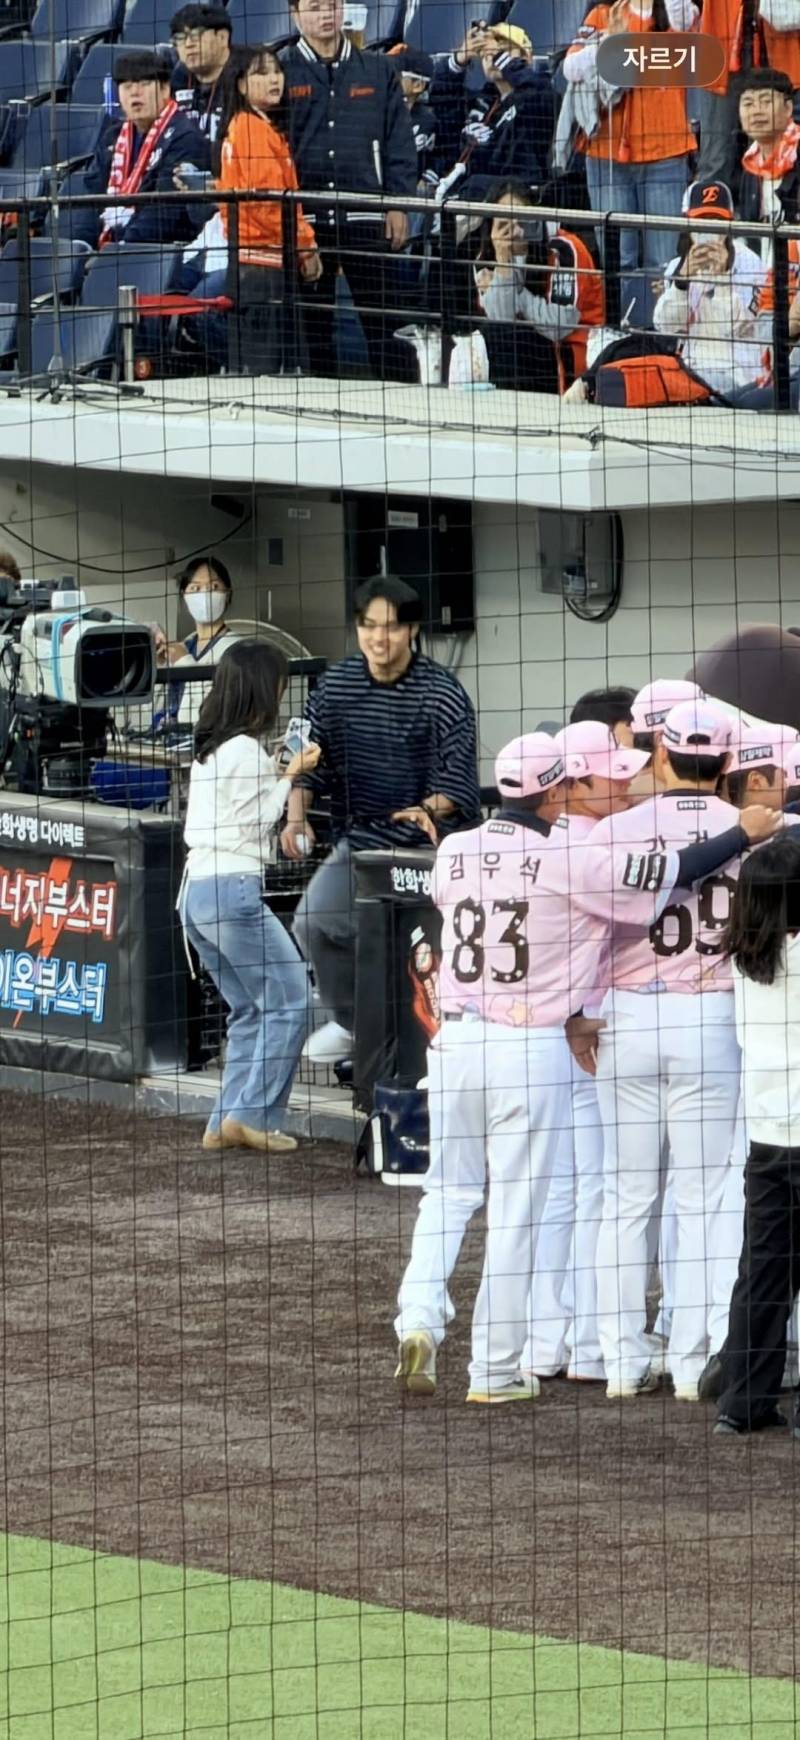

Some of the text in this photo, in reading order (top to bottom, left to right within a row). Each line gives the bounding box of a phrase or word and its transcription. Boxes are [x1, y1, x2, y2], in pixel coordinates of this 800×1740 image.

[0, 812, 84, 848] 화생명 다이렉트
[451, 896, 530, 983] 83
